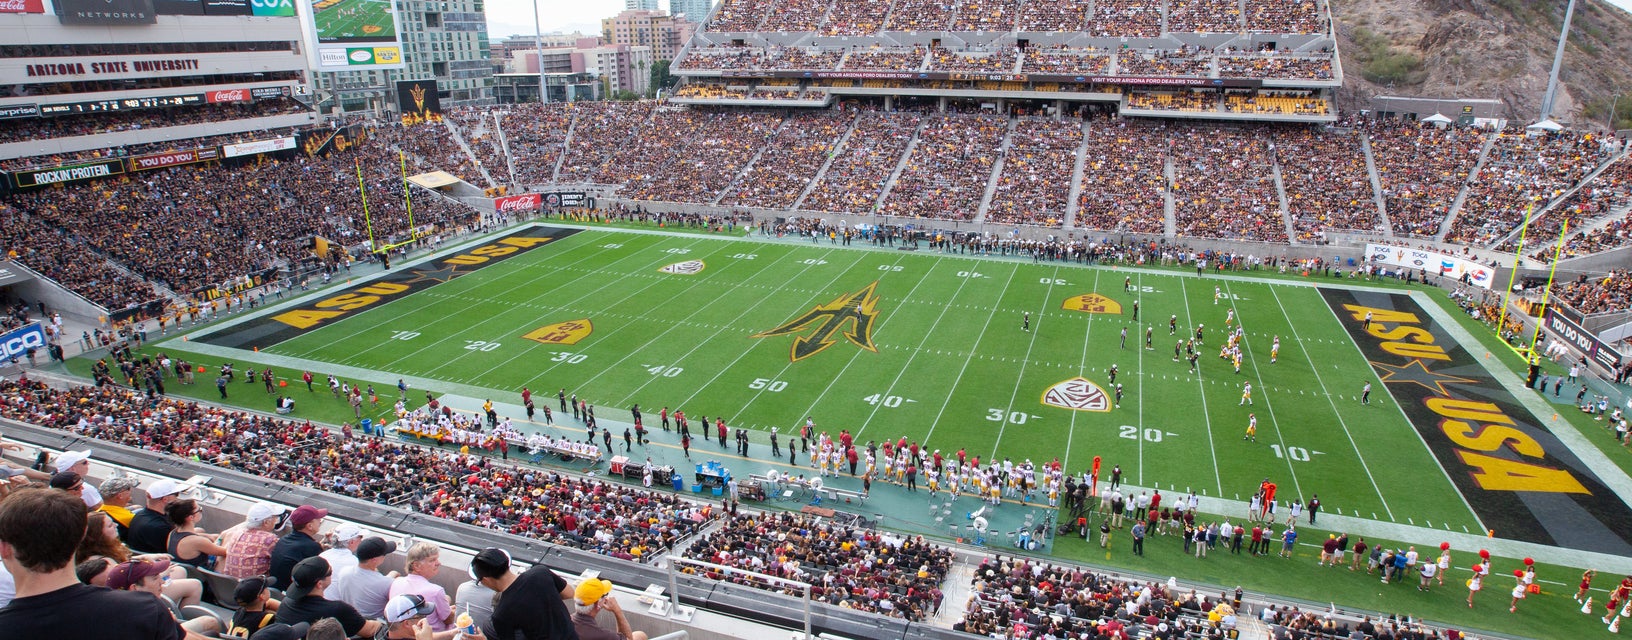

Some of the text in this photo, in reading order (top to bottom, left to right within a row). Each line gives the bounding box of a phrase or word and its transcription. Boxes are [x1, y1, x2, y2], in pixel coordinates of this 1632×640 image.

[26, 59, 199, 77] ARIZONA STATE UNIVERSITY
[214, 89, 243, 102] Coca-Cola
[139, 156, 160, 167] YOU
[160, 155, 174, 165] DO
[174, 153, 193, 164] YOU
[71, 164, 111, 180] PROTEIN
[501, 195, 536, 212] Coca-Cola
[1412, 251, 1428, 259] TOCA
[270, 282, 410, 329] ASU
[442, 236, 552, 265] USA
[391, 330, 421, 341] 10
[1552, 316, 1592, 352] YOU DO YOU
[463, 340, 501, 352] 20
[551, 351, 588, 364] 30
[647, 365, 684, 378] 40
[748, 378, 788, 392] 50
[863, 393, 903, 408] 40
[1342, 303, 1593, 497] ASU USA
[985, 408, 1028, 425] 30
[1119, 425, 1162, 443] 20
[1270, 444, 1311, 462] 10
